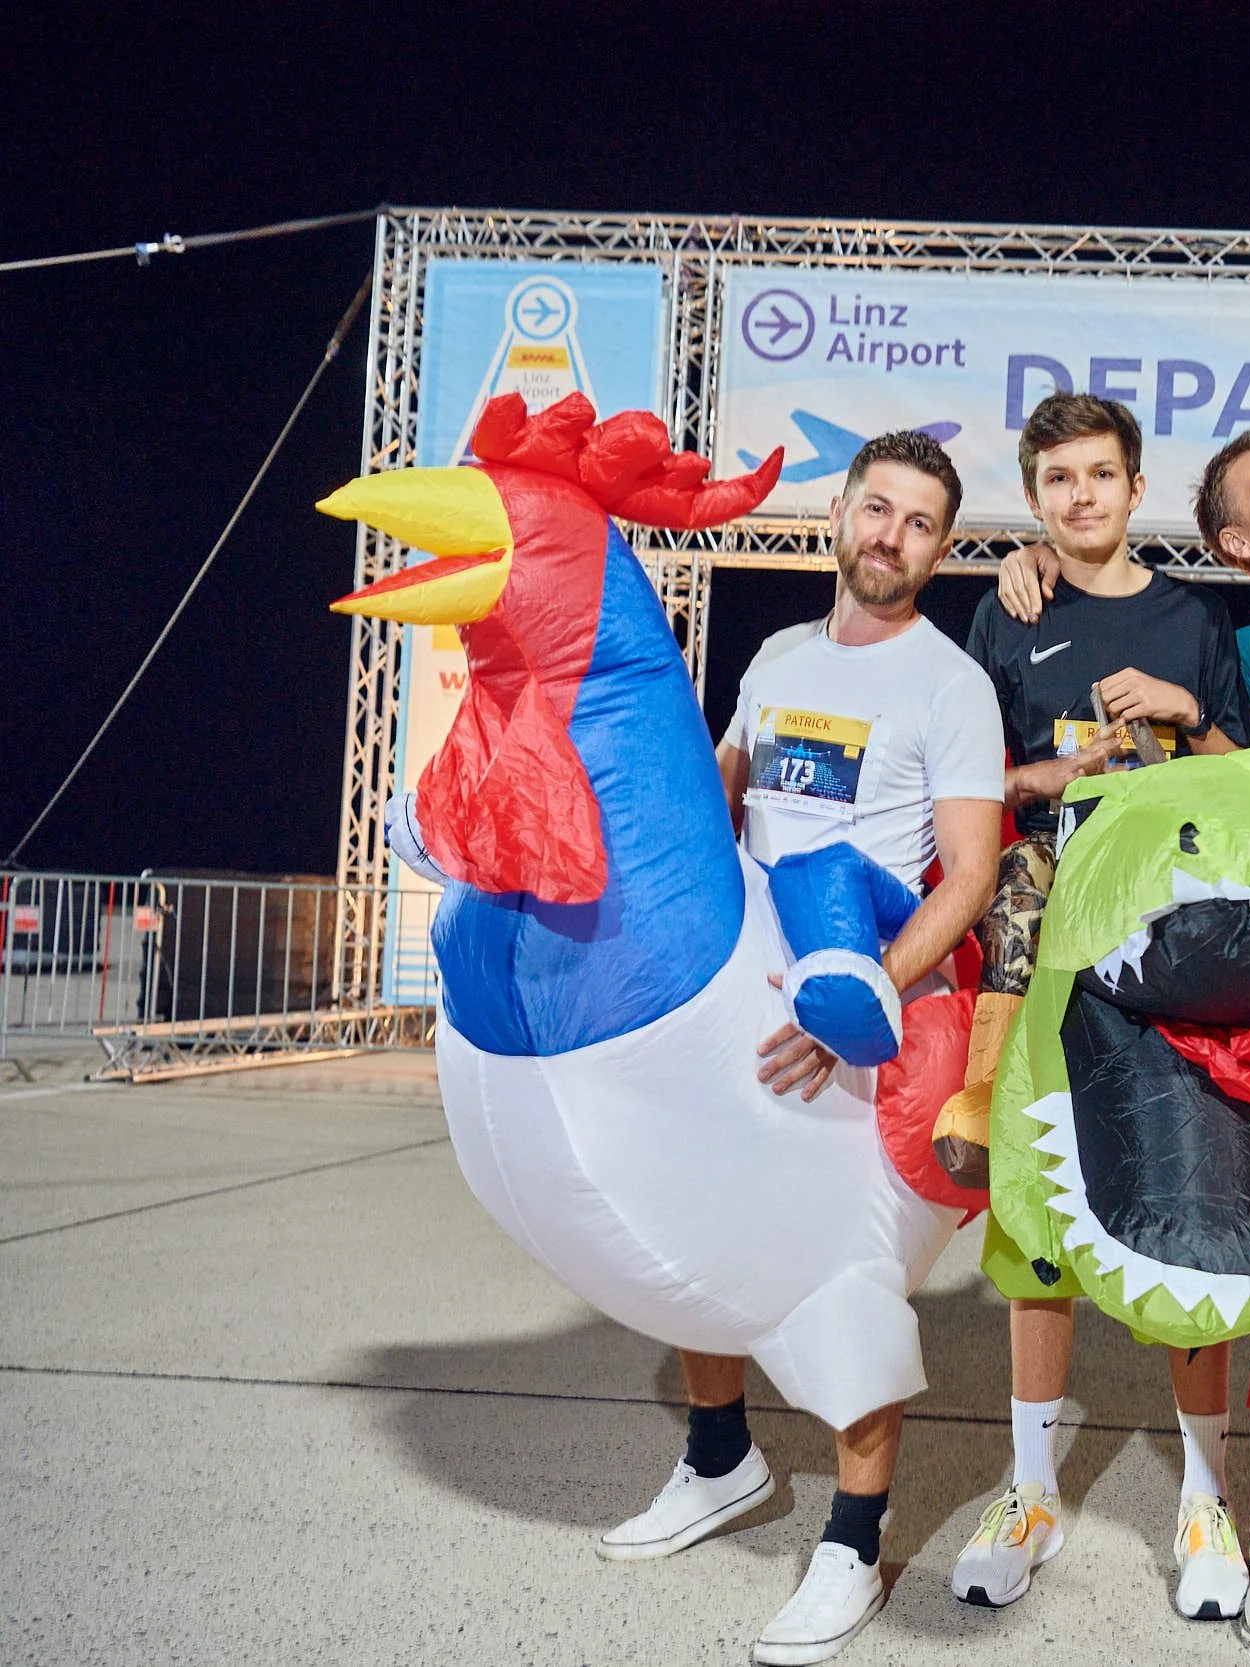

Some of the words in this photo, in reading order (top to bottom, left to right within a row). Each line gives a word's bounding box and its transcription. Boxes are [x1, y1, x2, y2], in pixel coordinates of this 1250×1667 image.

[829, 294, 908, 327] Linz
[826, 334, 966, 372] Airport
[784, 714, 832, 731] PATRICK
[780, 757, 816, 785] 173
